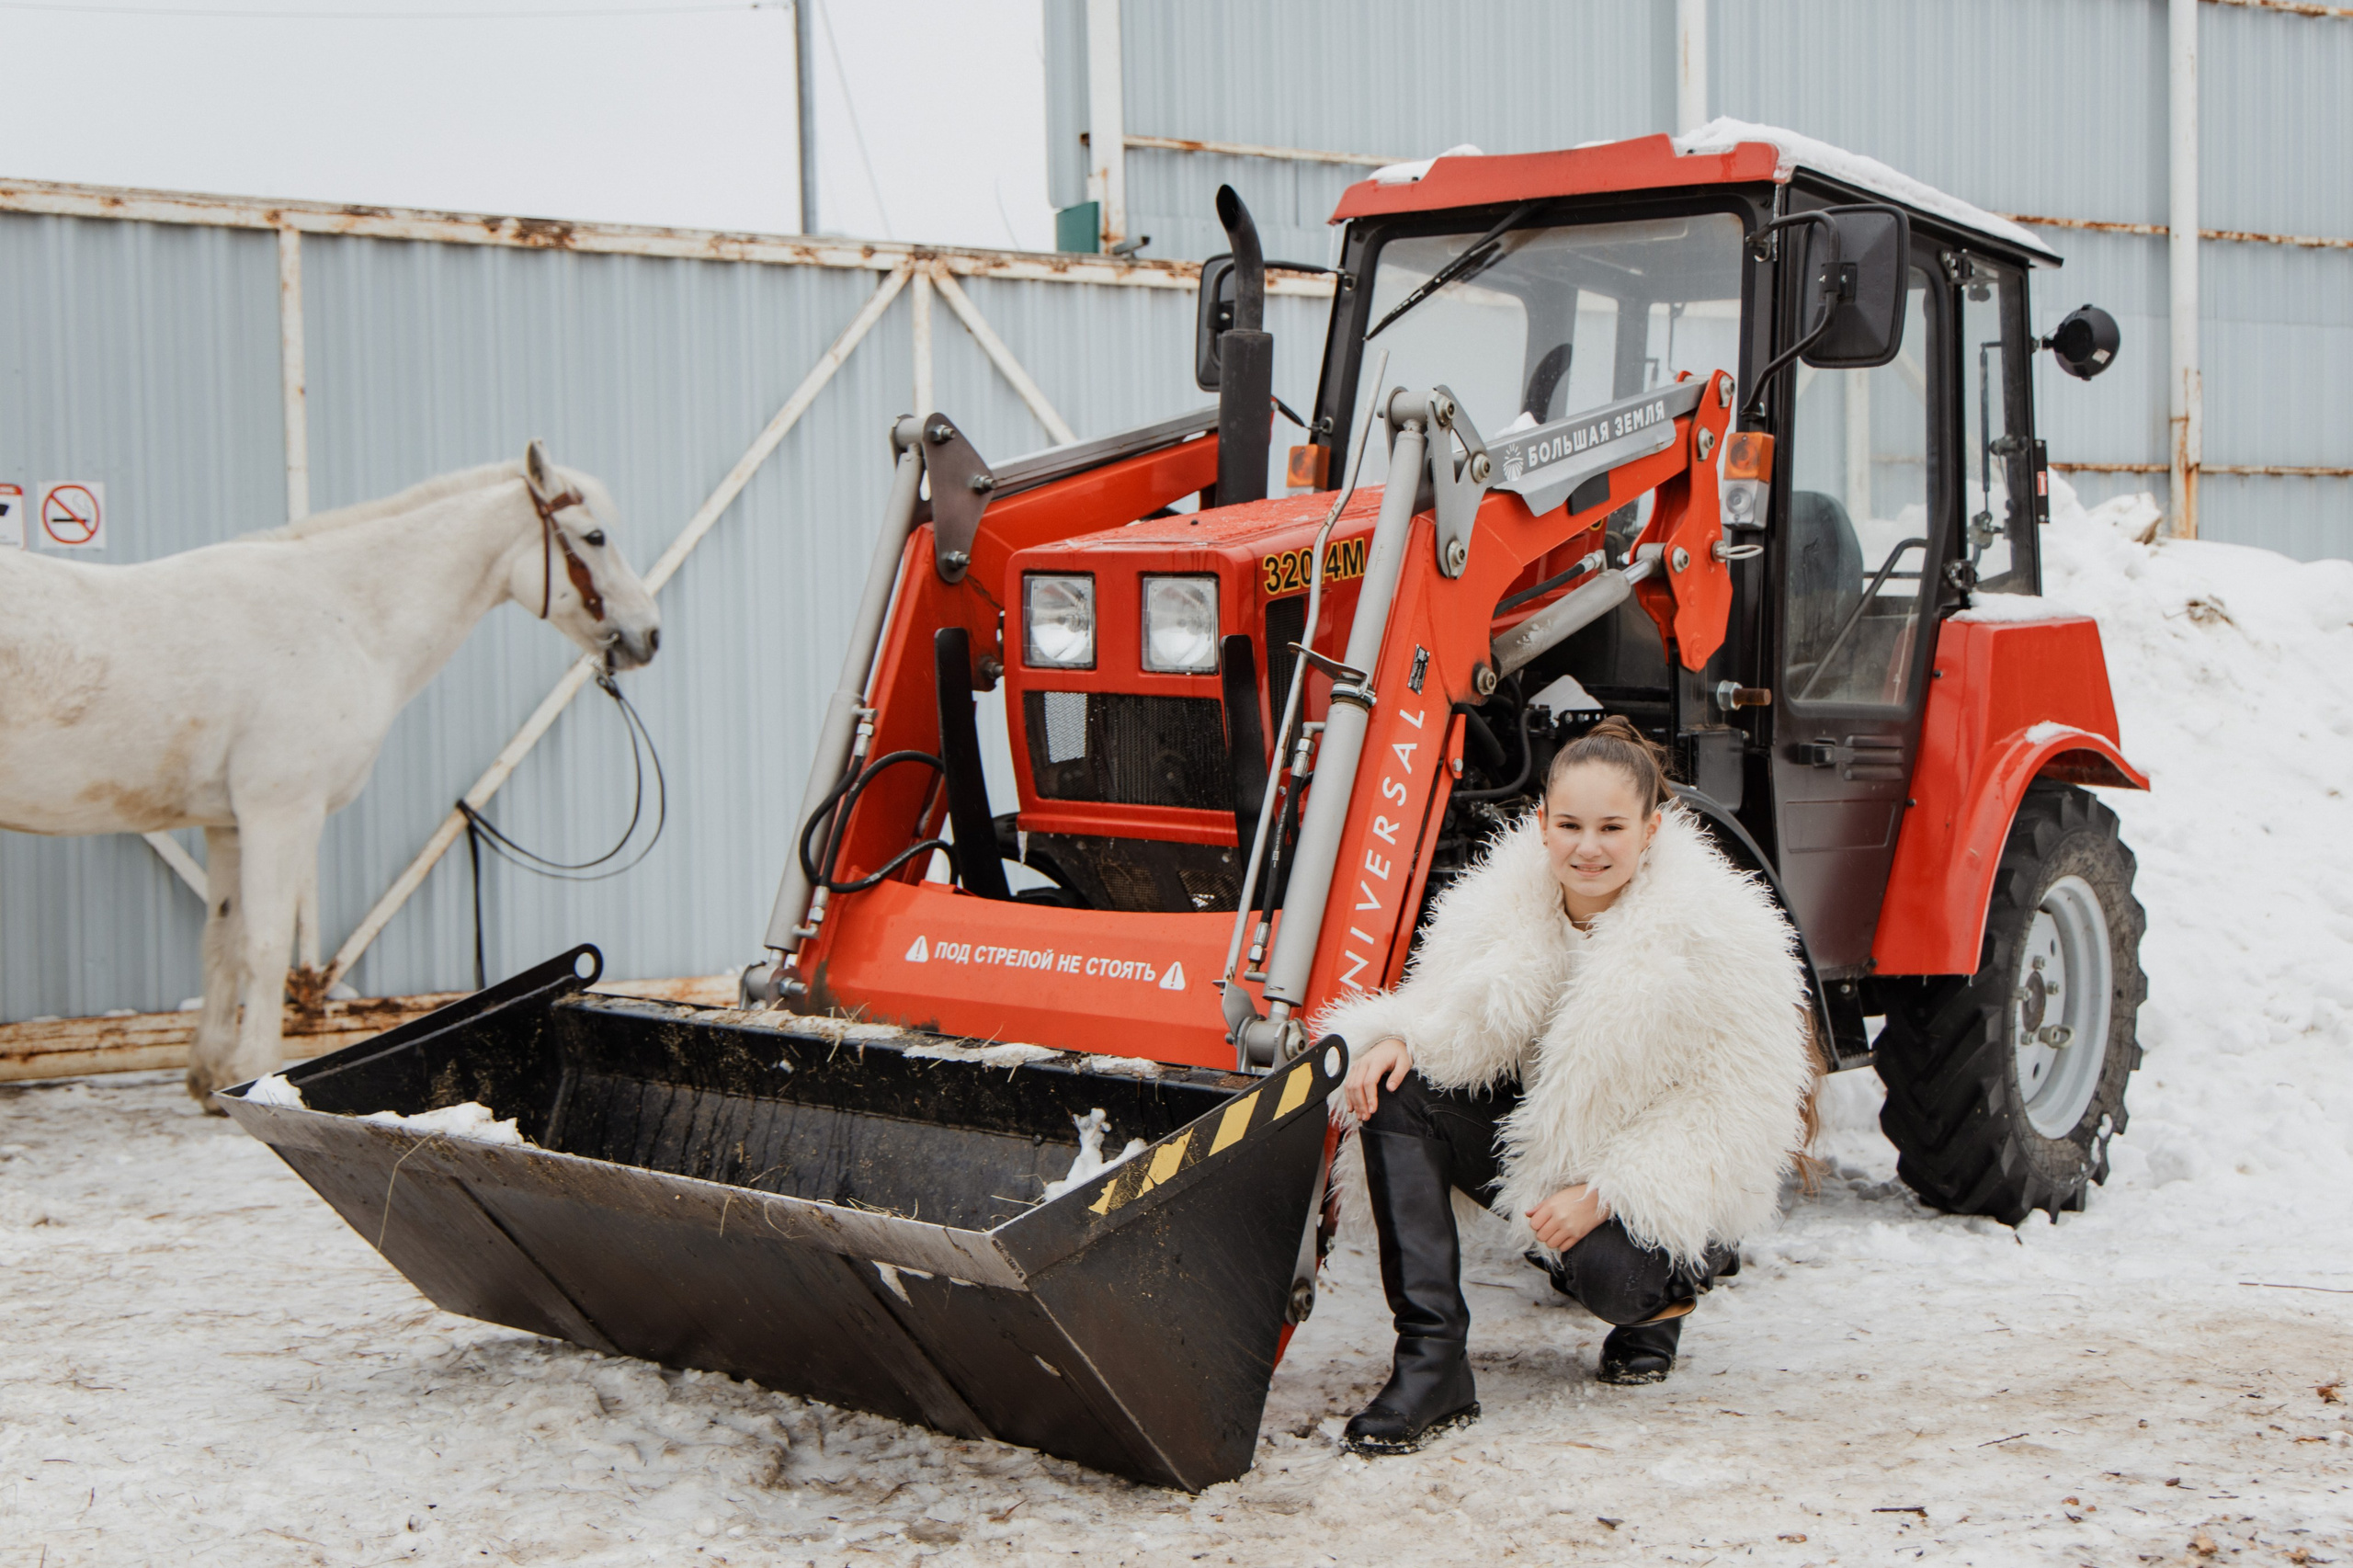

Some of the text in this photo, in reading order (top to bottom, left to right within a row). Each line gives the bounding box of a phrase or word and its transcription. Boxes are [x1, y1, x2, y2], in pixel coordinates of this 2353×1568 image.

[1528, 400, 1665, 468] БОЛЬШАЯ ЗЕМЛЯ
[1263, 538, 1365, 595] 3204M
[1334, 708, 1425, 1006] NIVERSAL
[935, 941, 1156, 983] ПОД СТРЕЛОЙ НЕ СТОЯТЬ
